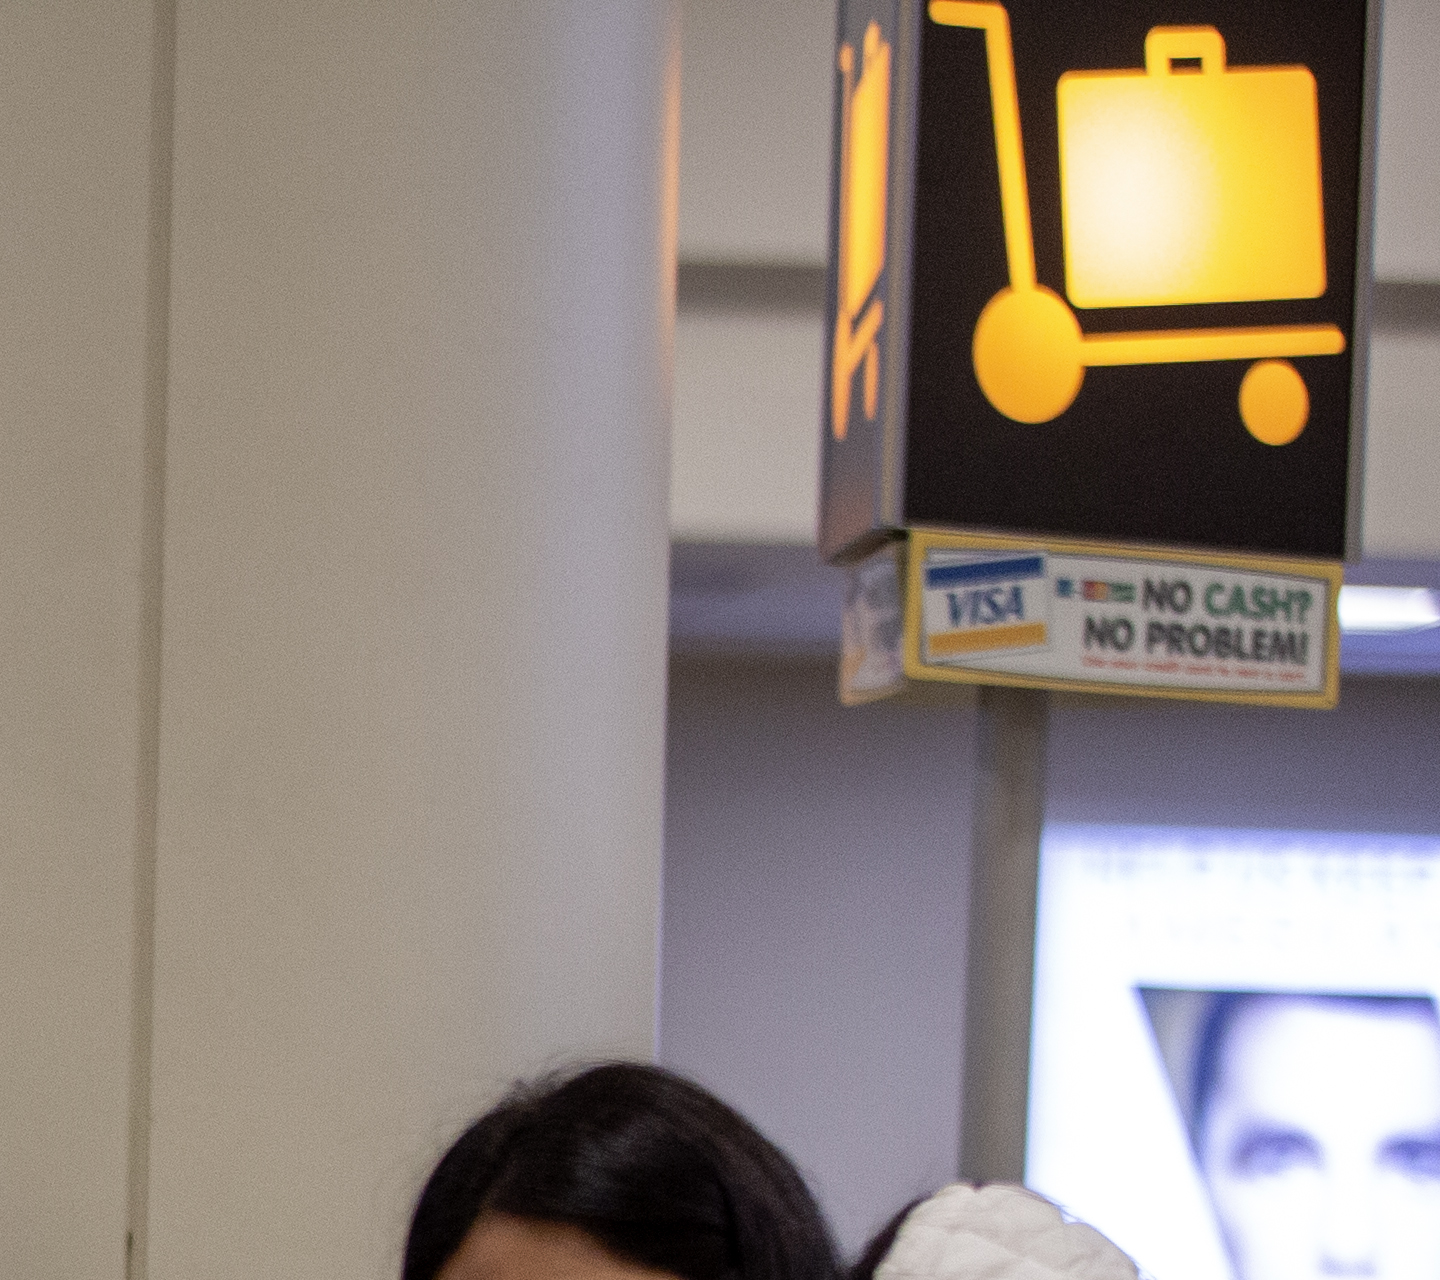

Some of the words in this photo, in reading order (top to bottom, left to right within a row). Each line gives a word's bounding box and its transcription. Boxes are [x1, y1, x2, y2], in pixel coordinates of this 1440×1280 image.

[944, 586, 1024, 629] VISA
[1141, 576, 1194, 616] NO
[1202, 582, 1313, 624] CASH?
[1082, 614, 1137, 654] NO
[1144, 618, 1310, 666] PROBLEM!
